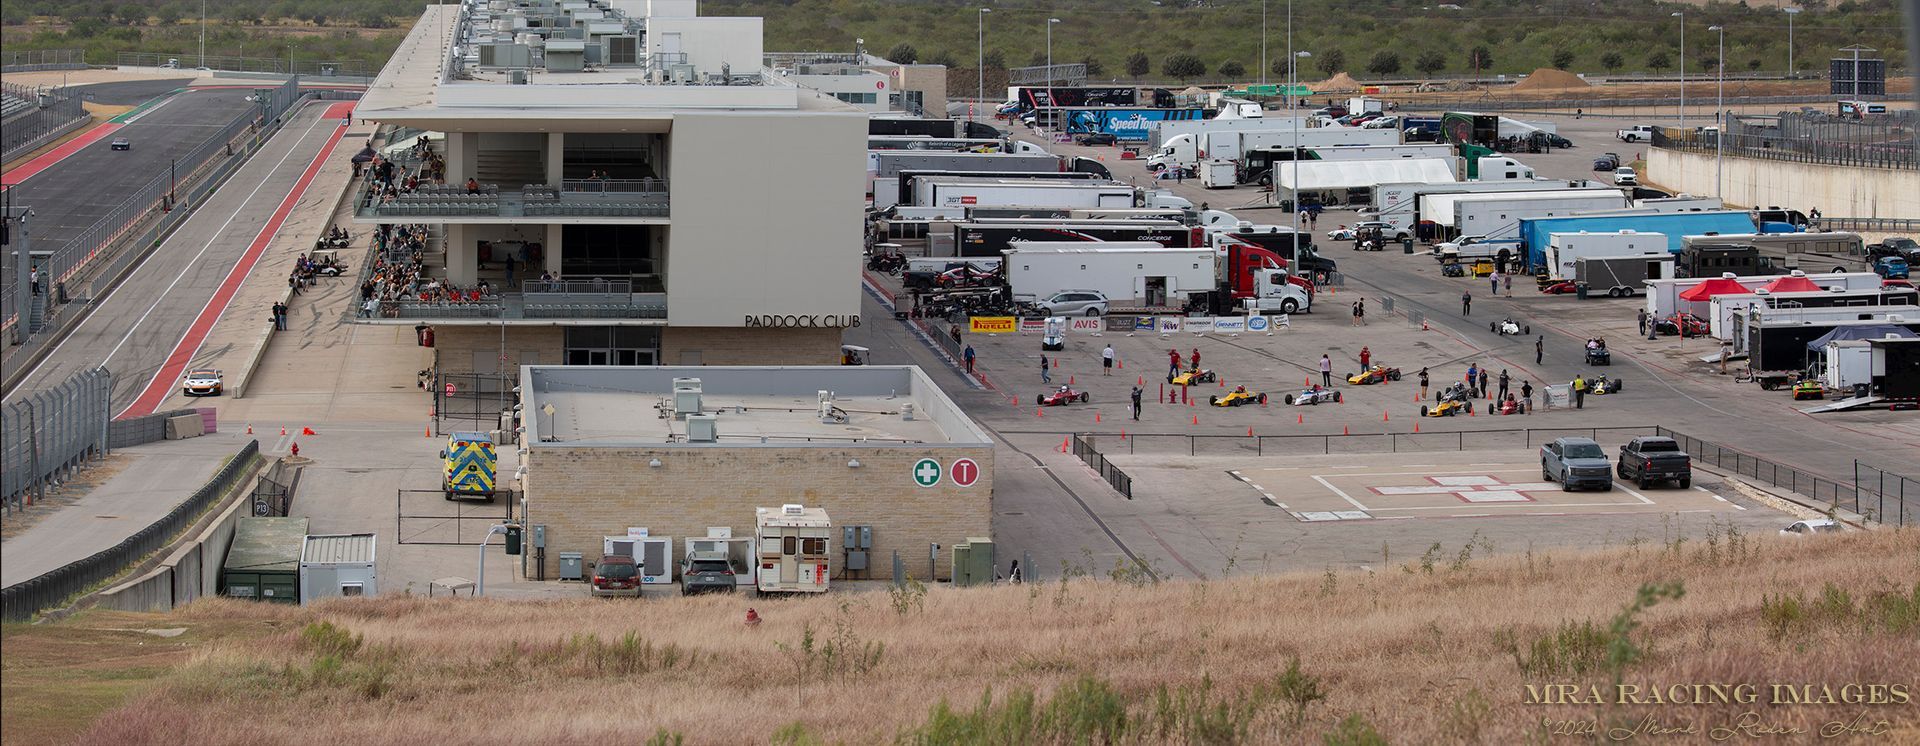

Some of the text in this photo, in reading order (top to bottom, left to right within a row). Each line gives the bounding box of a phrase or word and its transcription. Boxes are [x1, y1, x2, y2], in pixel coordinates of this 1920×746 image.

[745, 315, 861, 328] PADDOCK CLUB
[973, 319, 1012, 329] PIRELLI
[1074, 319, 1098, 329] AVIS
[256, 504, 267, 513] P13
